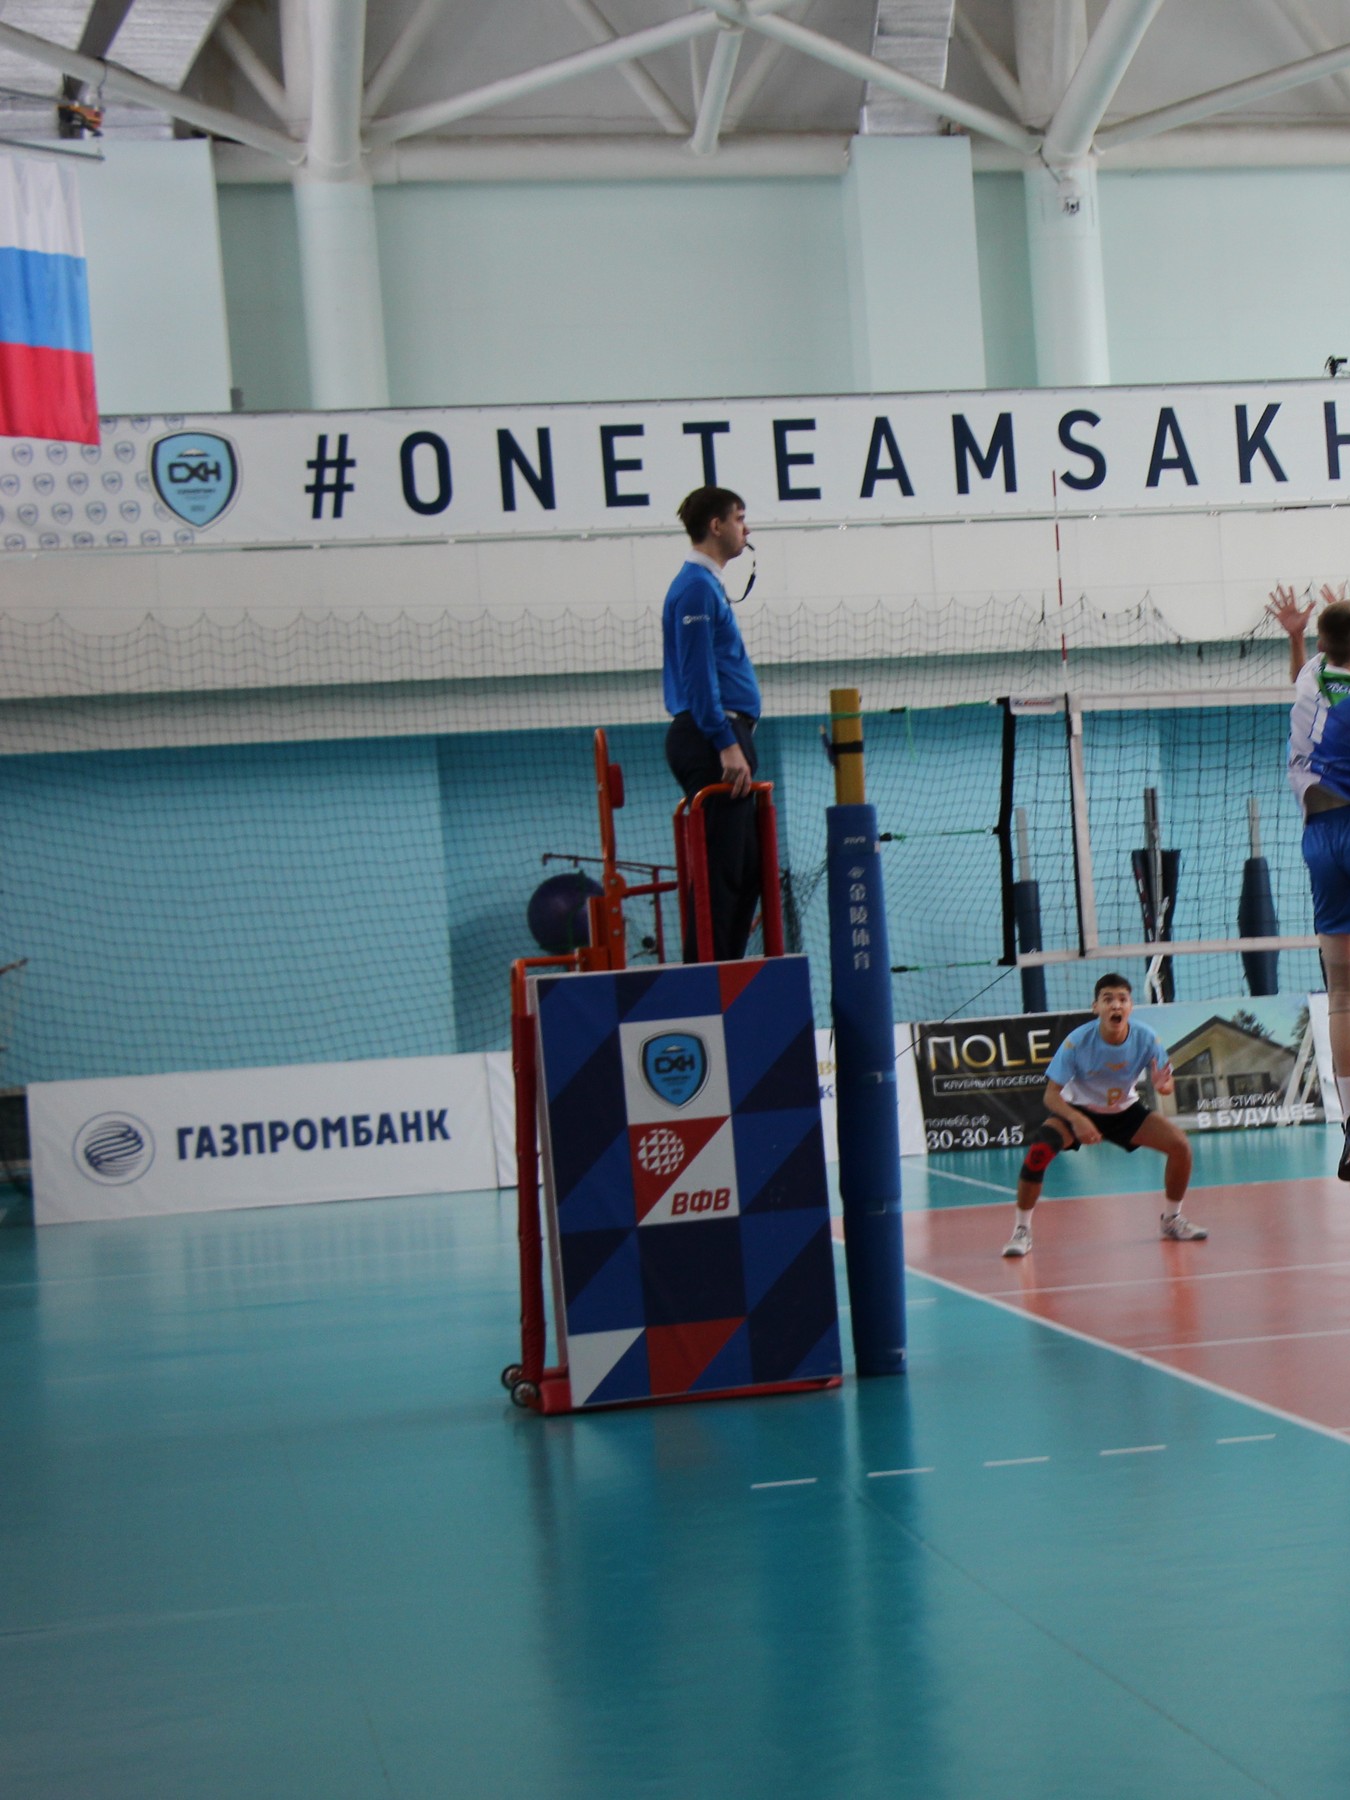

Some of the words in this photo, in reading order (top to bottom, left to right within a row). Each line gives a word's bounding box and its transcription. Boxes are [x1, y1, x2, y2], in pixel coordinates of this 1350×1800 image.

[1198, 1111, 1212, 1129] В
[1218, 1102, 1317, 1128] БУДУЩЕЕ
[176, 1108, 452, 1161] ГАЗПРОМБАНК
[671, 1187, 731, 1216] ВФВ
